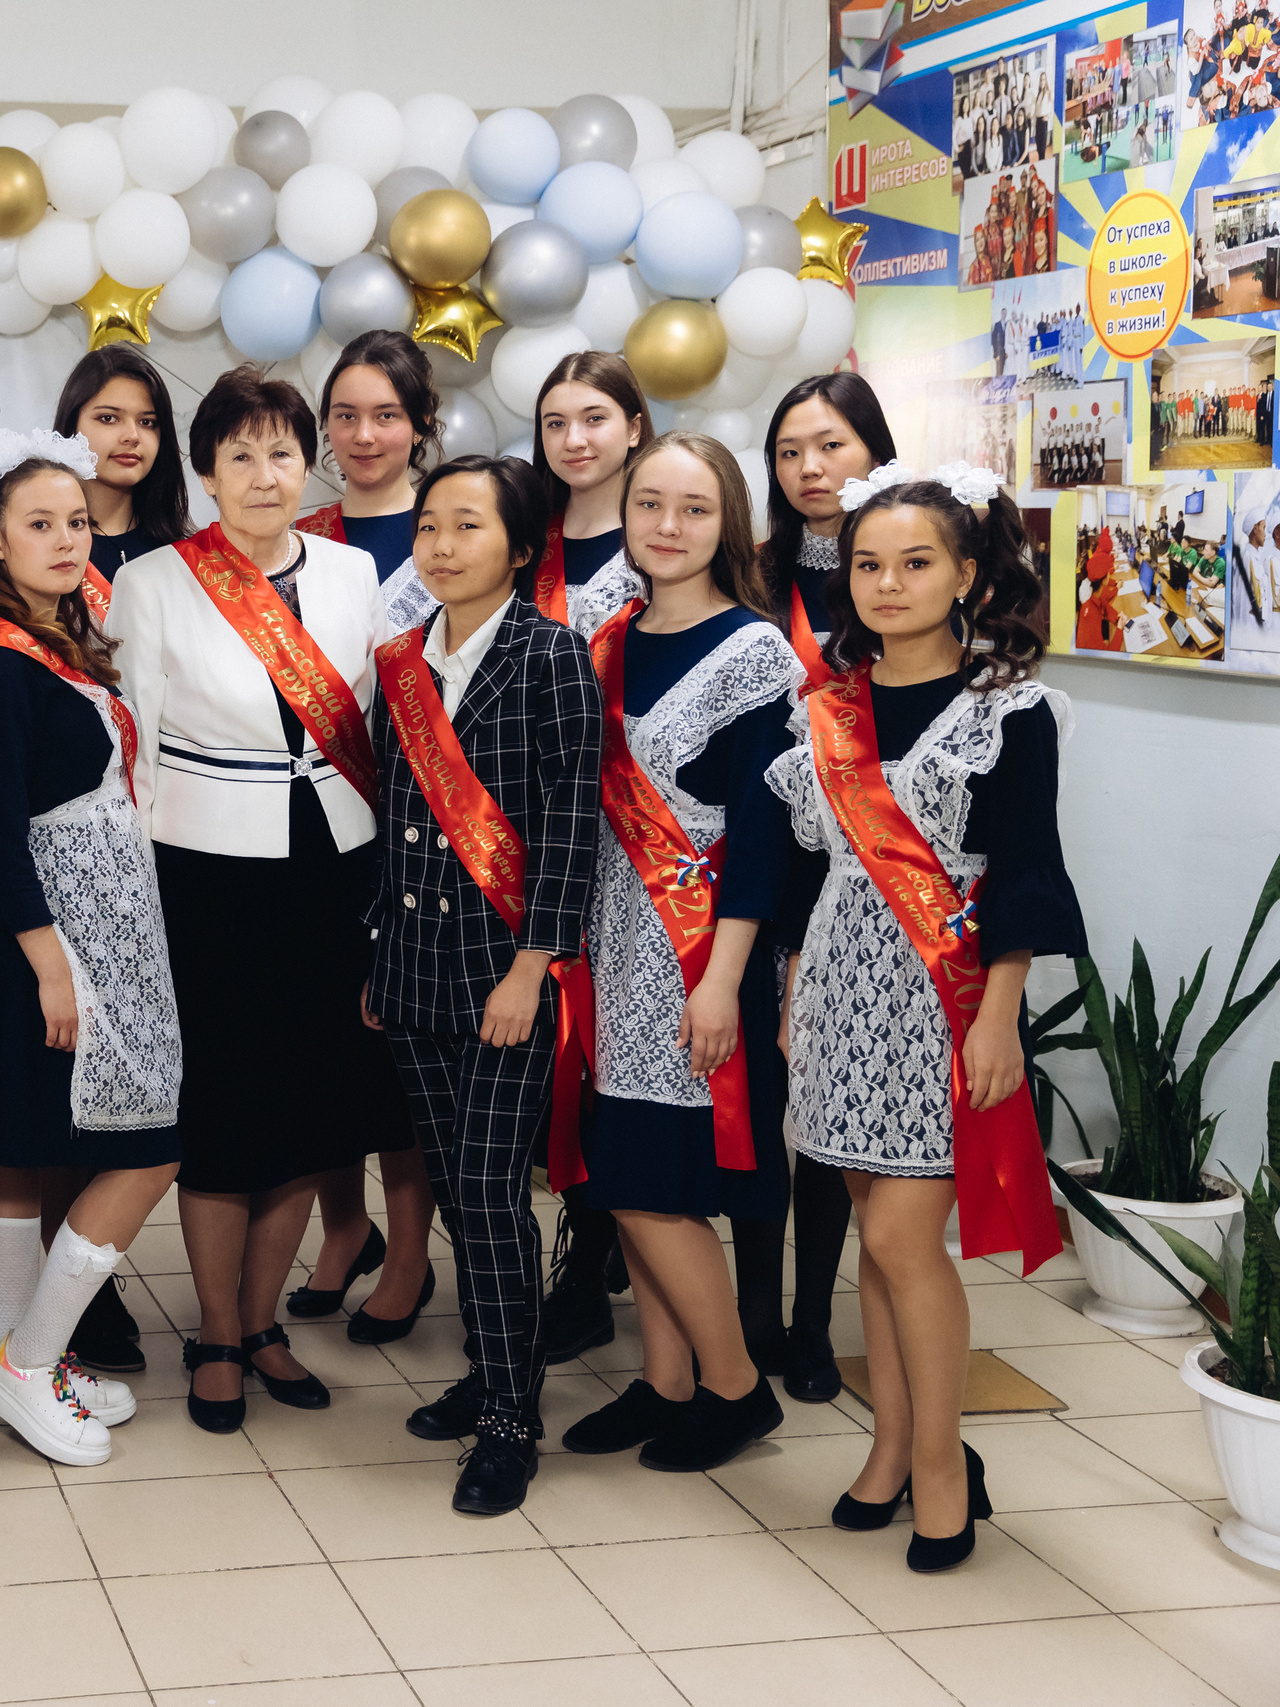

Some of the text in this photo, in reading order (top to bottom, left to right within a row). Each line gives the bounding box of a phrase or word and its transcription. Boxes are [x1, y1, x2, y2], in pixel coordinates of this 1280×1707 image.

[871, 155, 948, 194] ИНТЕРЕСОВ
[1107, 219, 1171, 244] От успеха
[1109, 253, 1167, 274] в школе-
[1110, 283, 1165, 306] к успеху
[1107, 309, 1166, 334] в жизни!
[243, 627, 275, 664] класс
[261, 609, 348, 714] Классный
[397, 668, 461, 808] Выпускник
[407, 744, 433, 793] Сурана
[828, 709, 897, 858] Выпускник
[630, 776, 658, 814] МАОУ
[486, 819, 519, 855] МАОУ
[618, 804, 638, 842] класс
[469, 852, 501, 889] класс
[642, 840, 717, 941] 2021
[905, 904, 938, 945] класс
